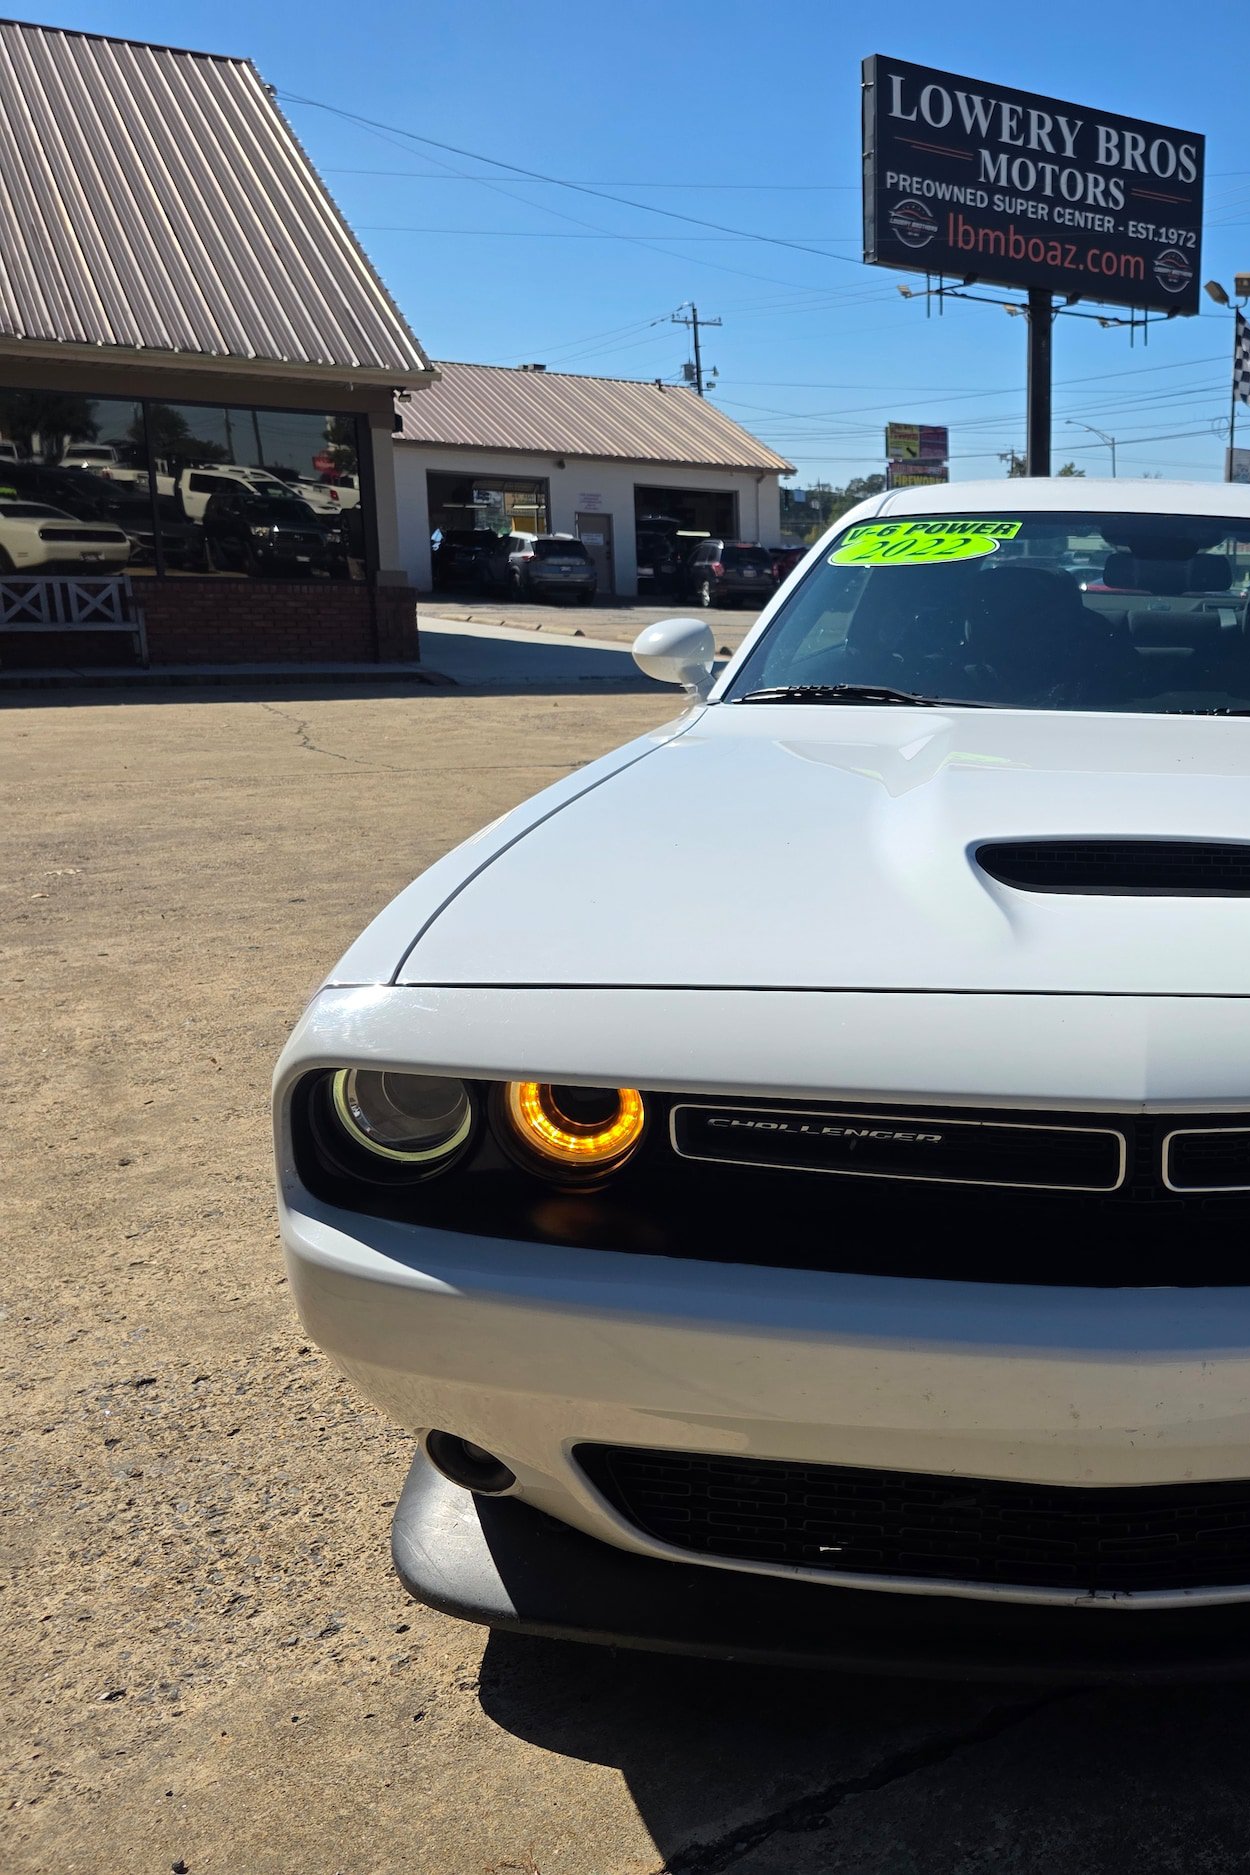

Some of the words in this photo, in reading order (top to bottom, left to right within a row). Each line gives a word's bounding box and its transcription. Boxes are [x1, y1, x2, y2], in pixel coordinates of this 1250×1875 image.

[887, 73, 1084, 159] LOWERY
[1095, 124, 1197, 184] BROS
[886, 170, 988, 209] PREOWNED
[993, 194, 1049, 222] SUPER
[1053, 207, 1115, 234] CENTER
[1127, 221, 1197, 248] EST.1972
[978, 148, 1125, 211] MOTORS
[947, 212, 1145, 281] lbmboaz.com
[852, 537, 973, 562] 2022
[903, 522, 1017, 536] POWER
[707, 1118, 944, 1144] CHALLENGER
